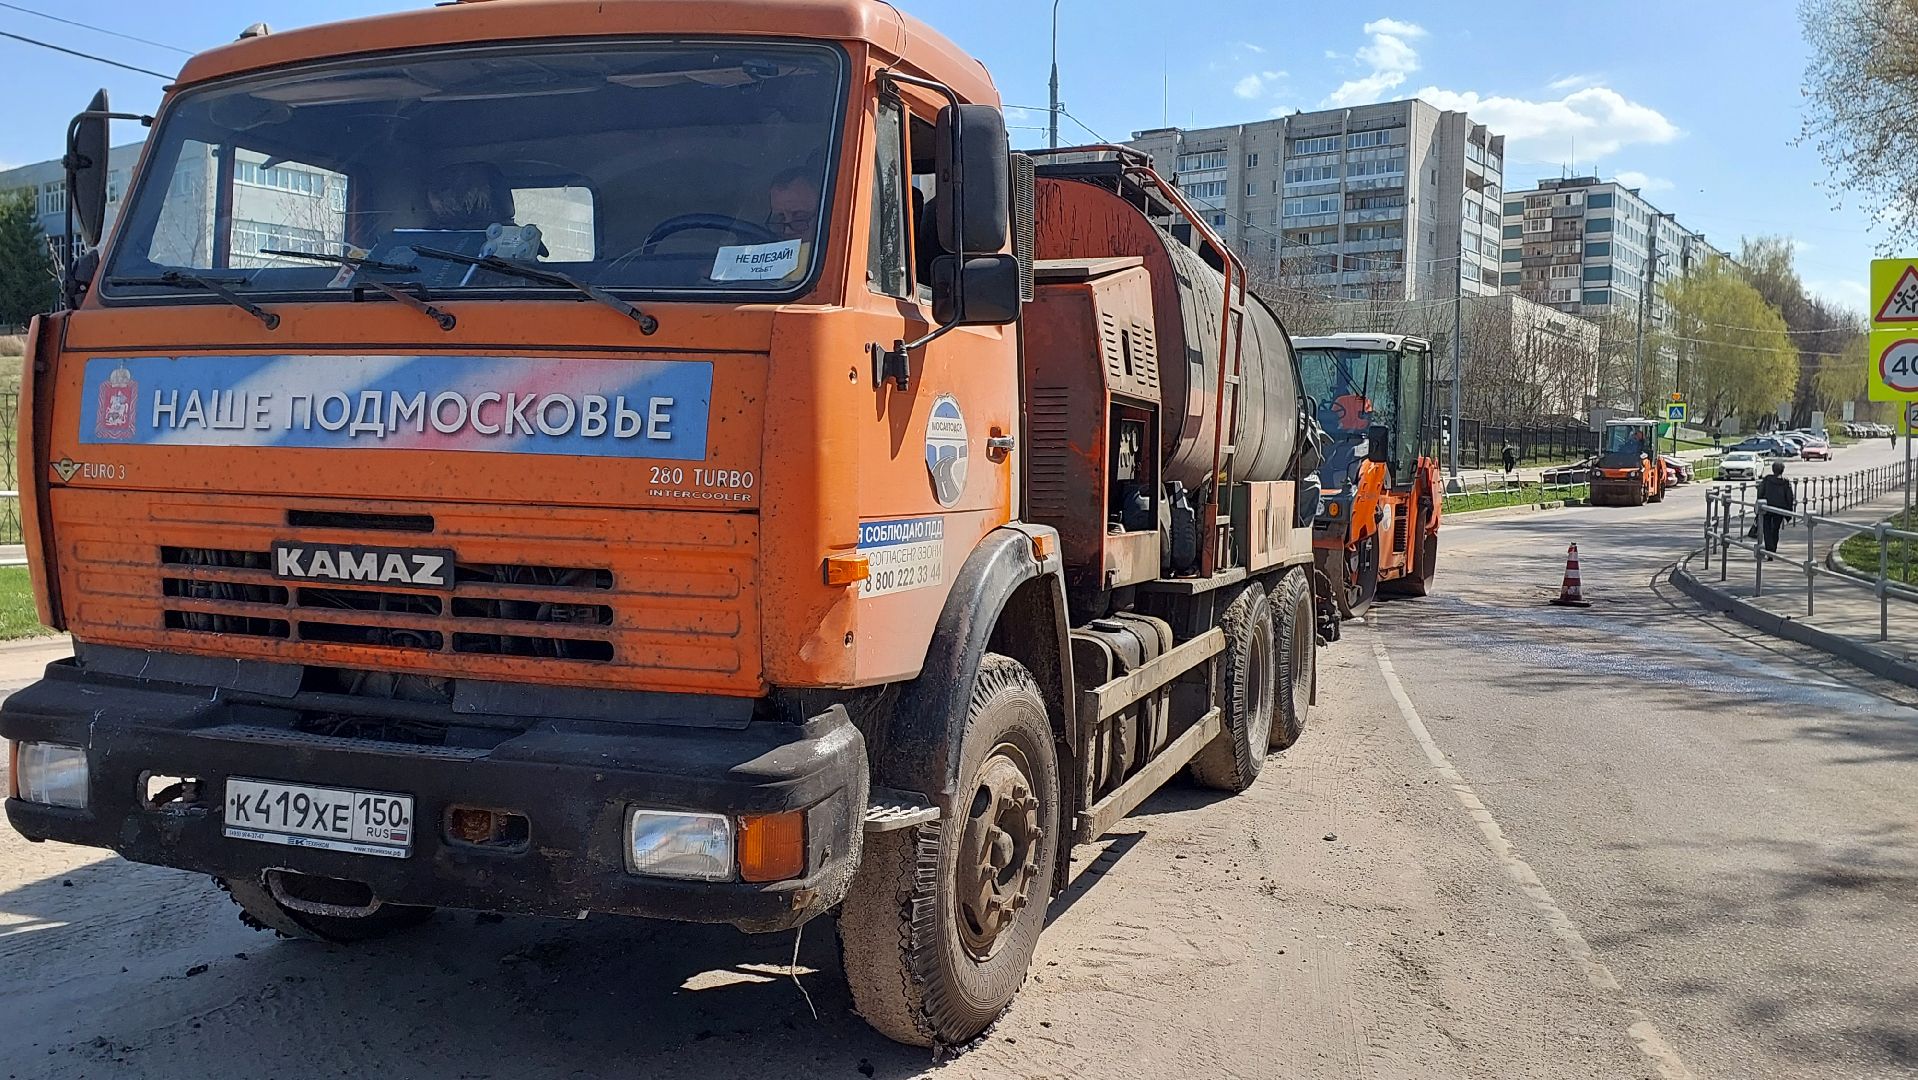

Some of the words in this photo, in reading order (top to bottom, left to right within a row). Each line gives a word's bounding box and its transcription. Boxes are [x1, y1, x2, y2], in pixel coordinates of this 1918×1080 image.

[736, 254, 750, 263] НЕ
[751, 248, 794, 263] ВЛЕЗАЙ!
[152, 388, 271, 430] НАШЕ
[283, 389, 675, 441] ПОДМОСКОВЬЕ
[83, 463, 115, 479] EURO
[118, 464, 125, 480] 3
[649, 466, 683, 485] 280
[693, 468, 754, 489] TURBO
[649, 489, 752, 502] INTERCOOLER
[865, 522, 924, 543] СОБЛЮДАЮ
[924, 520, 943, 539] ПДД
[277, 547, 445, 585] KAMAZ
[869, 548, 917, 567] СОГЛАСЕН?
[917, 544, 942, 561] ЗВОНИ
[865, 574, 872, 593] 8
[875, 570, 894, 591] 800
[897, 567, 915, 587] 222
[917, 564, 928, 583] 33
[930, 563, 941, 581] 44
[235, 789, 350, 833] К419ХЕ
[357, 797, 404, 828] 150
[366, 827, 389, 839] RUS
